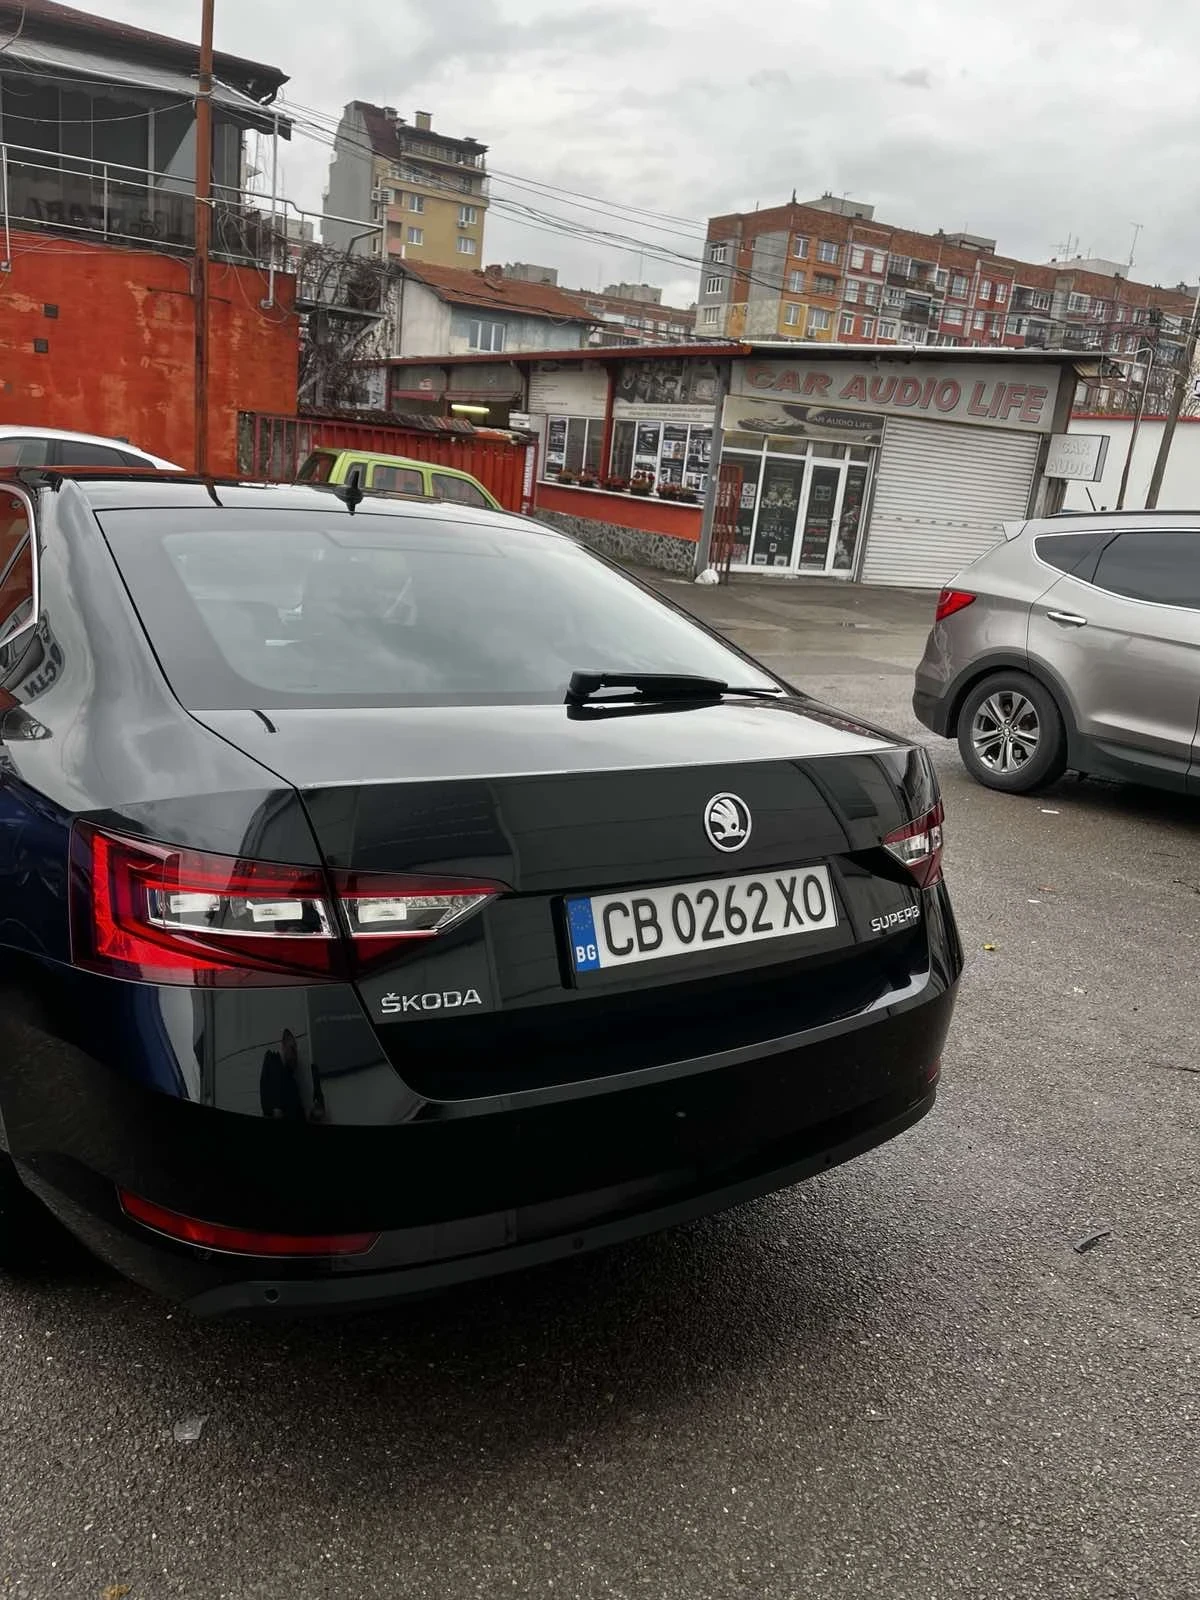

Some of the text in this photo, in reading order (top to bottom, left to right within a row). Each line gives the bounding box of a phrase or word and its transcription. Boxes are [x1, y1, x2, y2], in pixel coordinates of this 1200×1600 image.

[746, 366, 1049, 424] CAR AUDIO LIFE
[826, 417, 853, 427] AUDIO
[1062, 440, 1090, 457] CAR
[1047, 459, 1094, 477] AUDIO
[602, 874, 827, 956] CB 0262 XO
[870, 905, 920, 932] SUPERB
[575, 944, 597, 963] BG
[381, 989, 482, 1014] ŠKODA
